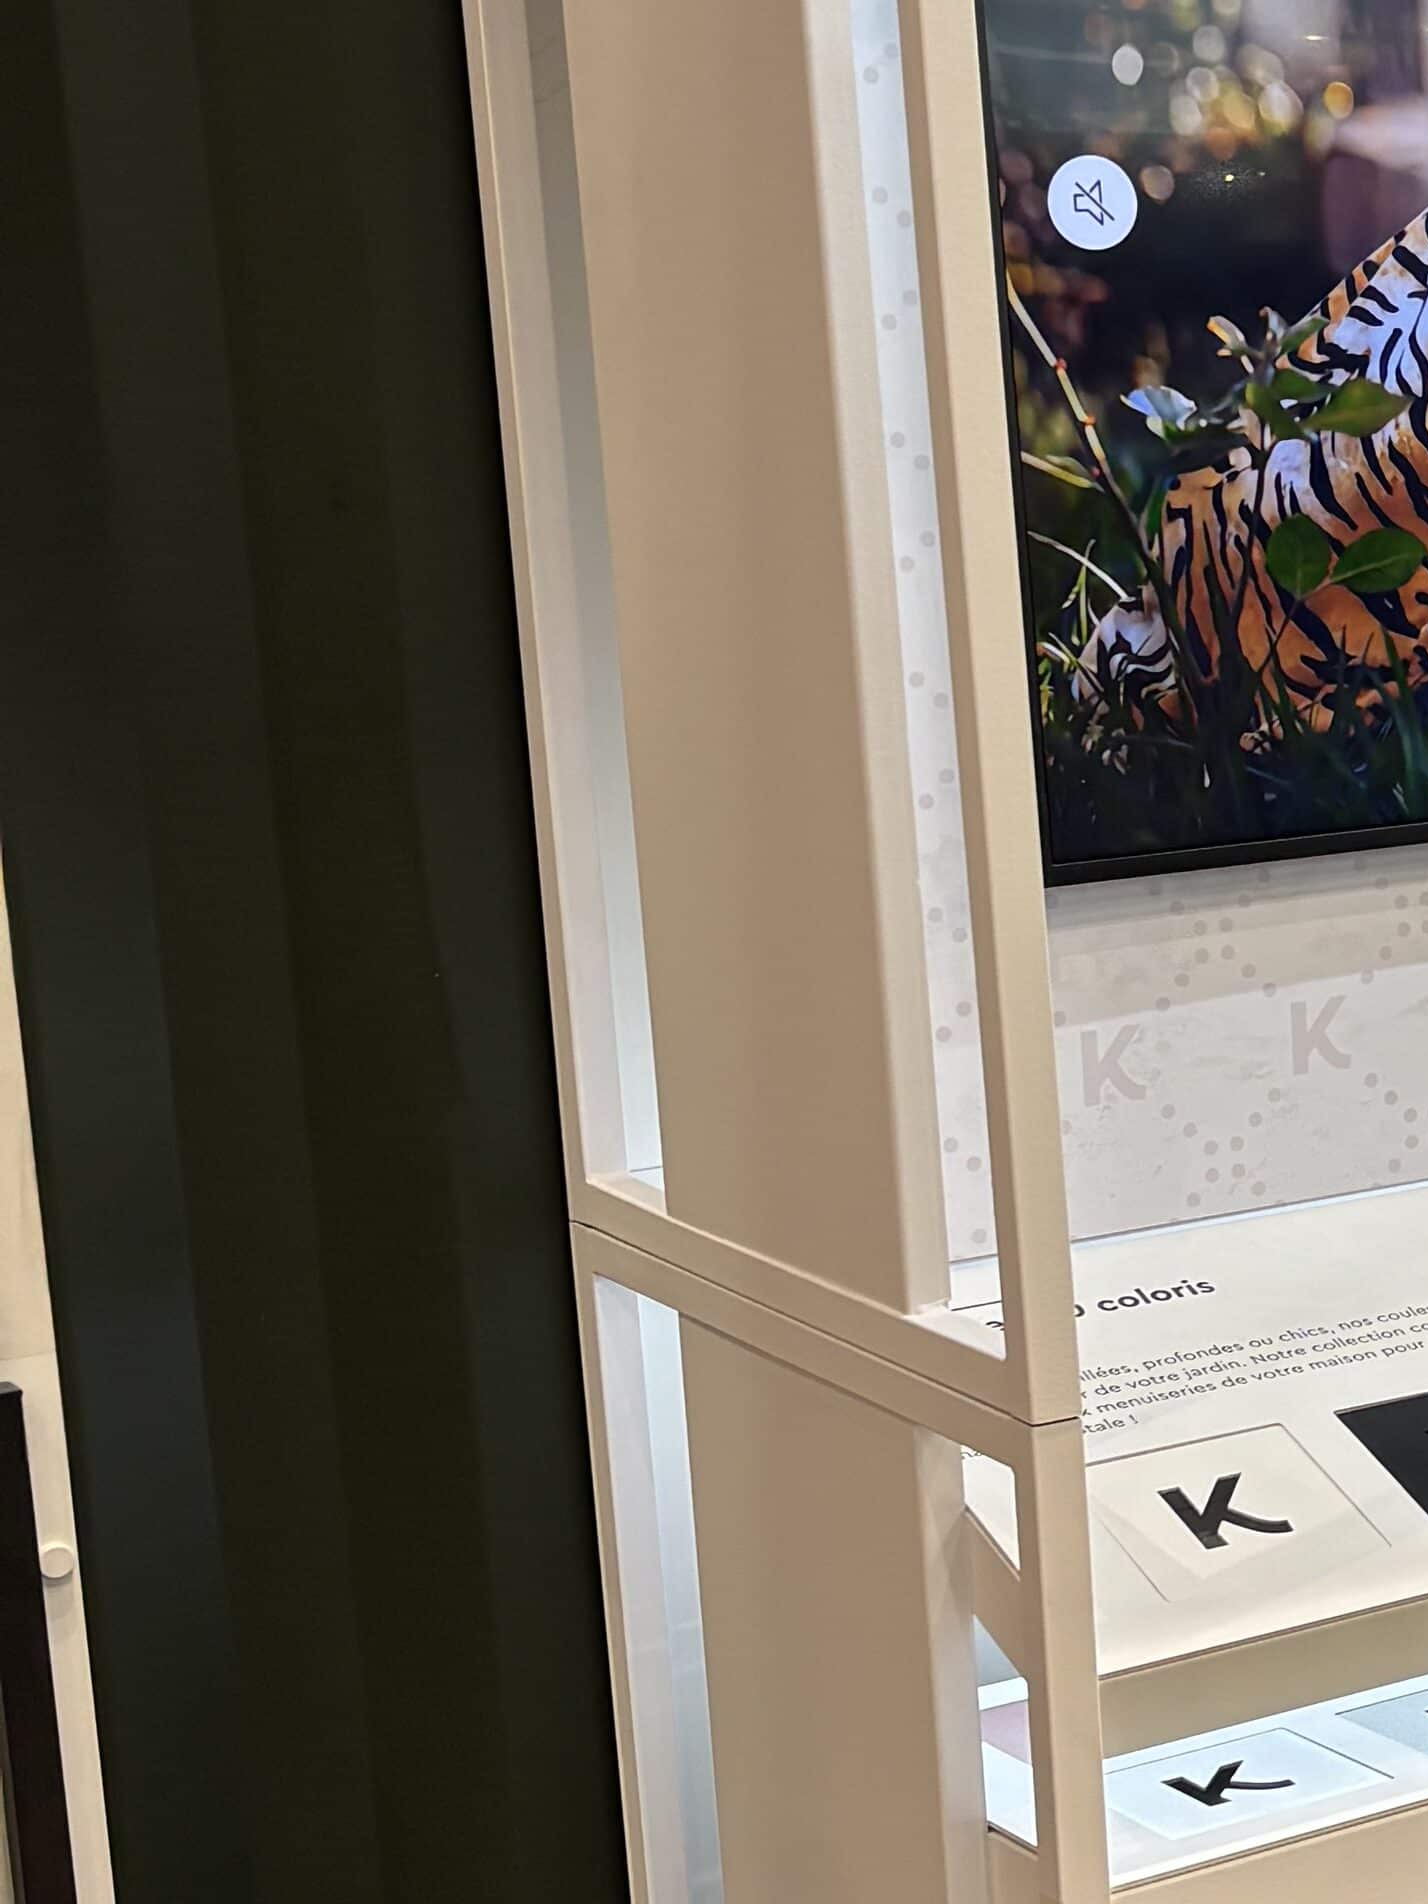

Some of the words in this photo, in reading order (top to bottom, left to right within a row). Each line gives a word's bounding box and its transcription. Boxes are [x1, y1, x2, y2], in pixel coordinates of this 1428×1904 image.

[1082, 1024, 1146, 1107] K
[1289, 996, 1351, 1075] K
[1097, 1279, 1216, 1313] coloris
[1094, 1382, 1121, 1398] de
[1125, 1371, 1180, 1392] votre
[1181, 1358, 1248, 1387] jardin.
[1252, 1344, 1307, 1365] Notre
[1311, 1325, 1406, 1354] collection
[1096, 1381, 1217, 1415] menuiseries
[1221, 1372, 1248, 1388] de
[1251, 1362, 1305, 1381] votre
[1309, 1350, 1377, 1371] maison
[1382, 1339, 1427, 1360] pour
[1142, 1340, 1245, 1372] profondes
[1249, 1335, 1273, 1348] ou
[1278, 1323, 1336, 1346] chics,
[1338, 1317, 1374, 1331] nos
[1158, 1471, 1293, 1550] K
[1160, 1759, 1296, 1807] K
